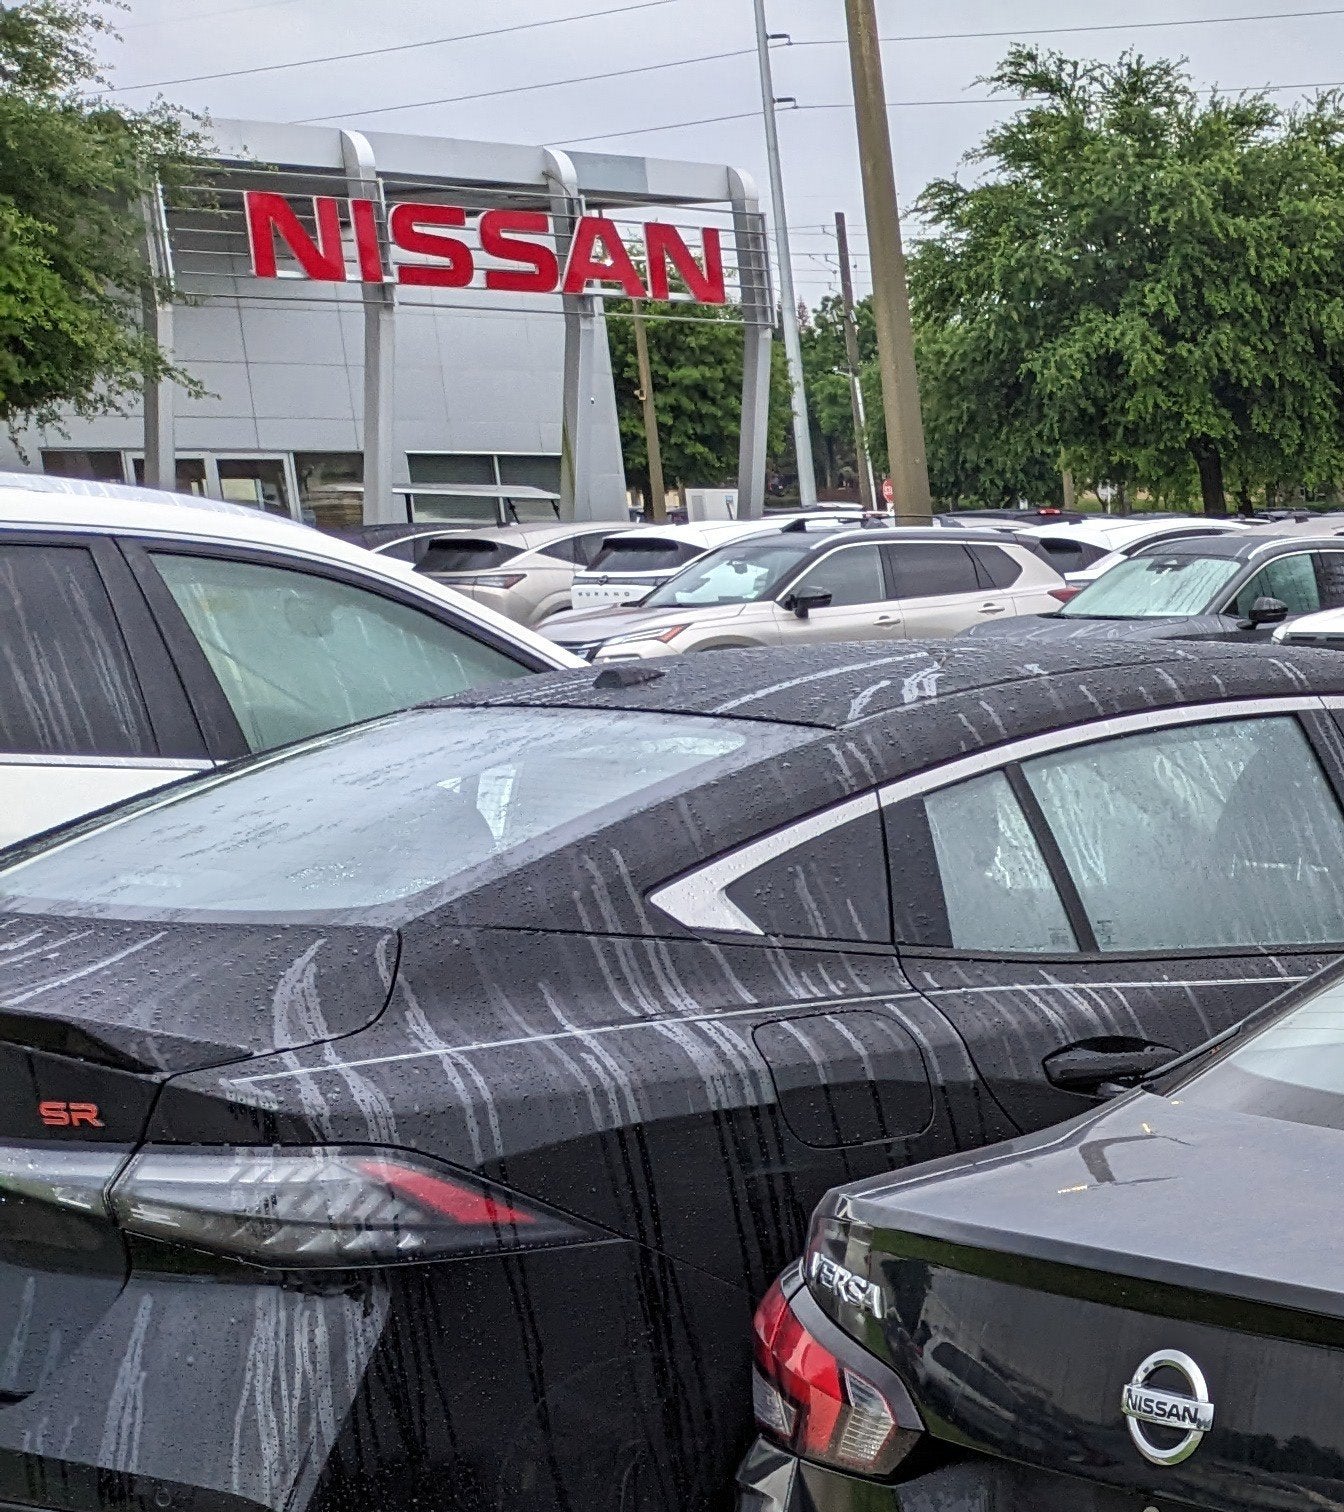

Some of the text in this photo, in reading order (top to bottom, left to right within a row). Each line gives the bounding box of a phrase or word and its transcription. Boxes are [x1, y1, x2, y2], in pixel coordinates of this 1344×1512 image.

[244, 190, 727, 306] NISSAN
[39, 1101, 106, 1127] SR
[811, 1251, 883, 1319] VERSA
[1126, 1387, 1199, 1424] NISSAN
